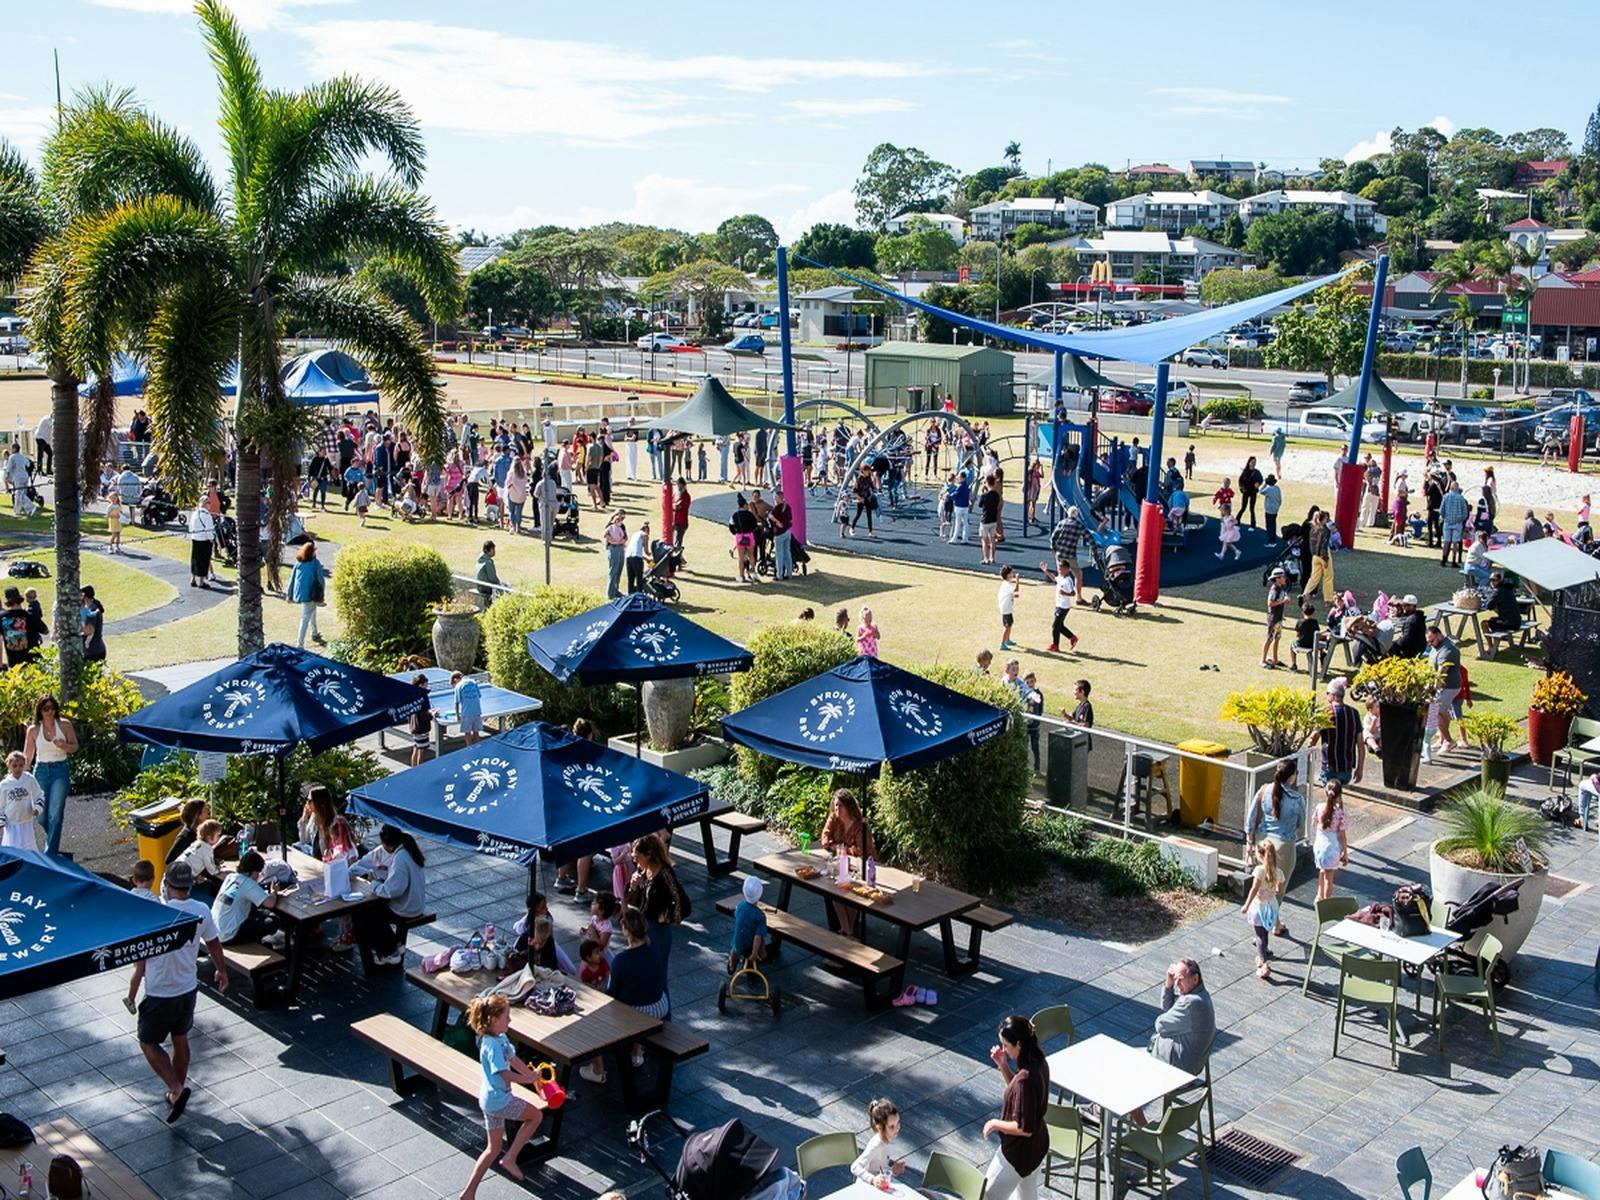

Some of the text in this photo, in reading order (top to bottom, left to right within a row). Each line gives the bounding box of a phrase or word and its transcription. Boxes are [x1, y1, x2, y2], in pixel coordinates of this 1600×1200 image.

[629, 622, 678, 640] BYRON BAY
[323, 667, 347, 679] BAY
[215, 679, 267, 702] BYRON BAY
[810, 690, 856, 716] BYRON BAY
[906, 689, 927, 703] BAY
[202, 703, 254, 729] BREWERY
[799, 716, 844, 742] BREWERY
[462, 757, 518, 790] BYRON BAY
[586, 763, 613, 777] BAY
[443, 783, 499, 815] BREWERY
[582, 785, 632, 814] BREWERY
[9, 891, 47, 910] BAY
[113, 931, 180, 958] BYRON BAY
